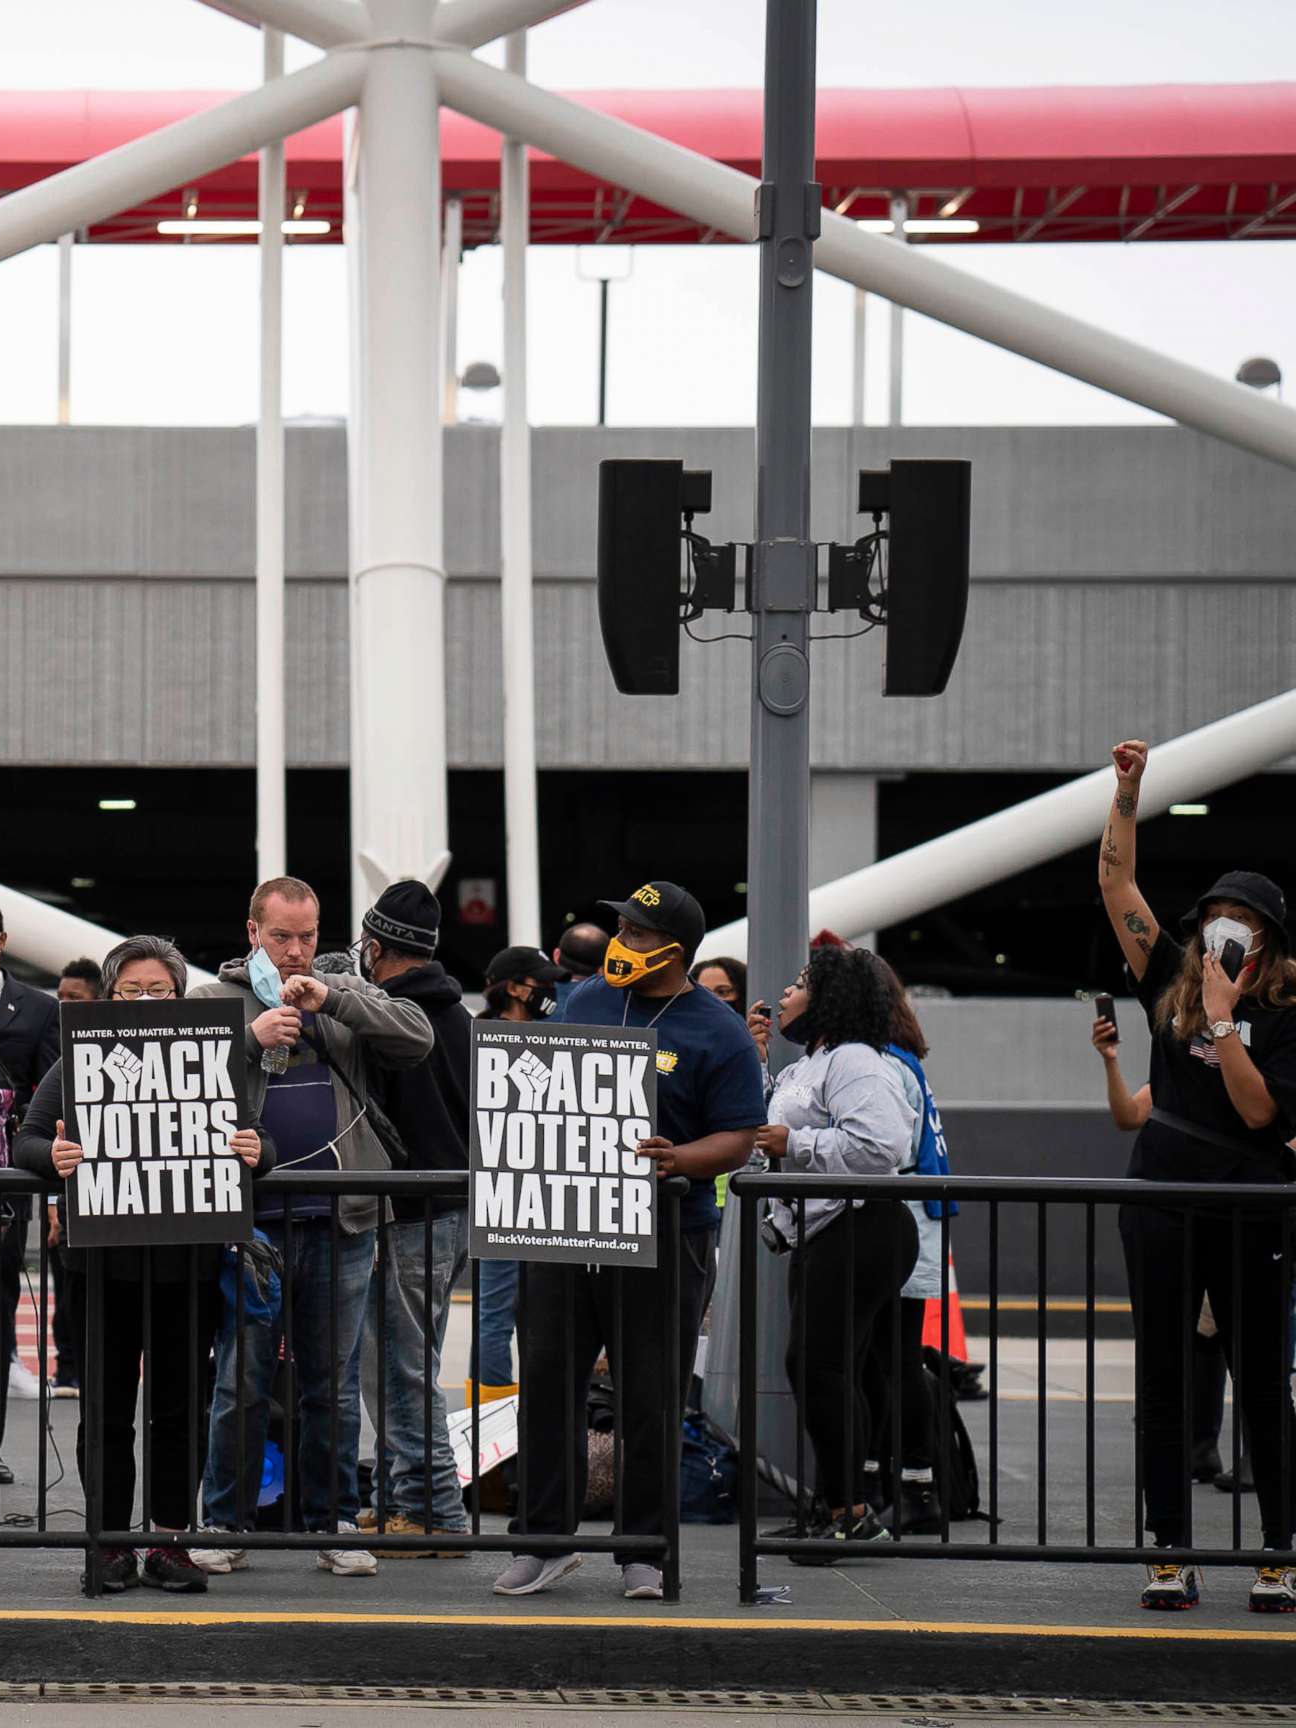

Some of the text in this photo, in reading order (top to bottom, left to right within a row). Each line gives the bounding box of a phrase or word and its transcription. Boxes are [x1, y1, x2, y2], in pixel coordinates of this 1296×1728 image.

[77, 1029, 115, 1038] MATTER.
[116, 1029, 137, 1037] YOU
[138, 1028, 177, 1037] MATTER.
[178, 1028, 194, 1036] WE
[195, 1026, 233, 1035] MATTER.
[482, 1034, 523, 1044] MATTER.
[525, 1036, 547, 1045] YOU
[549, 1037, 589, 1047] MATTER.
[591, 1039, 608, 1048] WE
[609, 1039, 651, 1050] MATTER.
[75, 1101, 238, 1159] VOTERS
[476, 1110, 652, 1176] VOTERS
[77, 1158, 242, 1216] MATTER
[474, 1171, 652, 1236] MATTER
[487, 1233, 639, 1252] BlackVotersMatterFund.org
